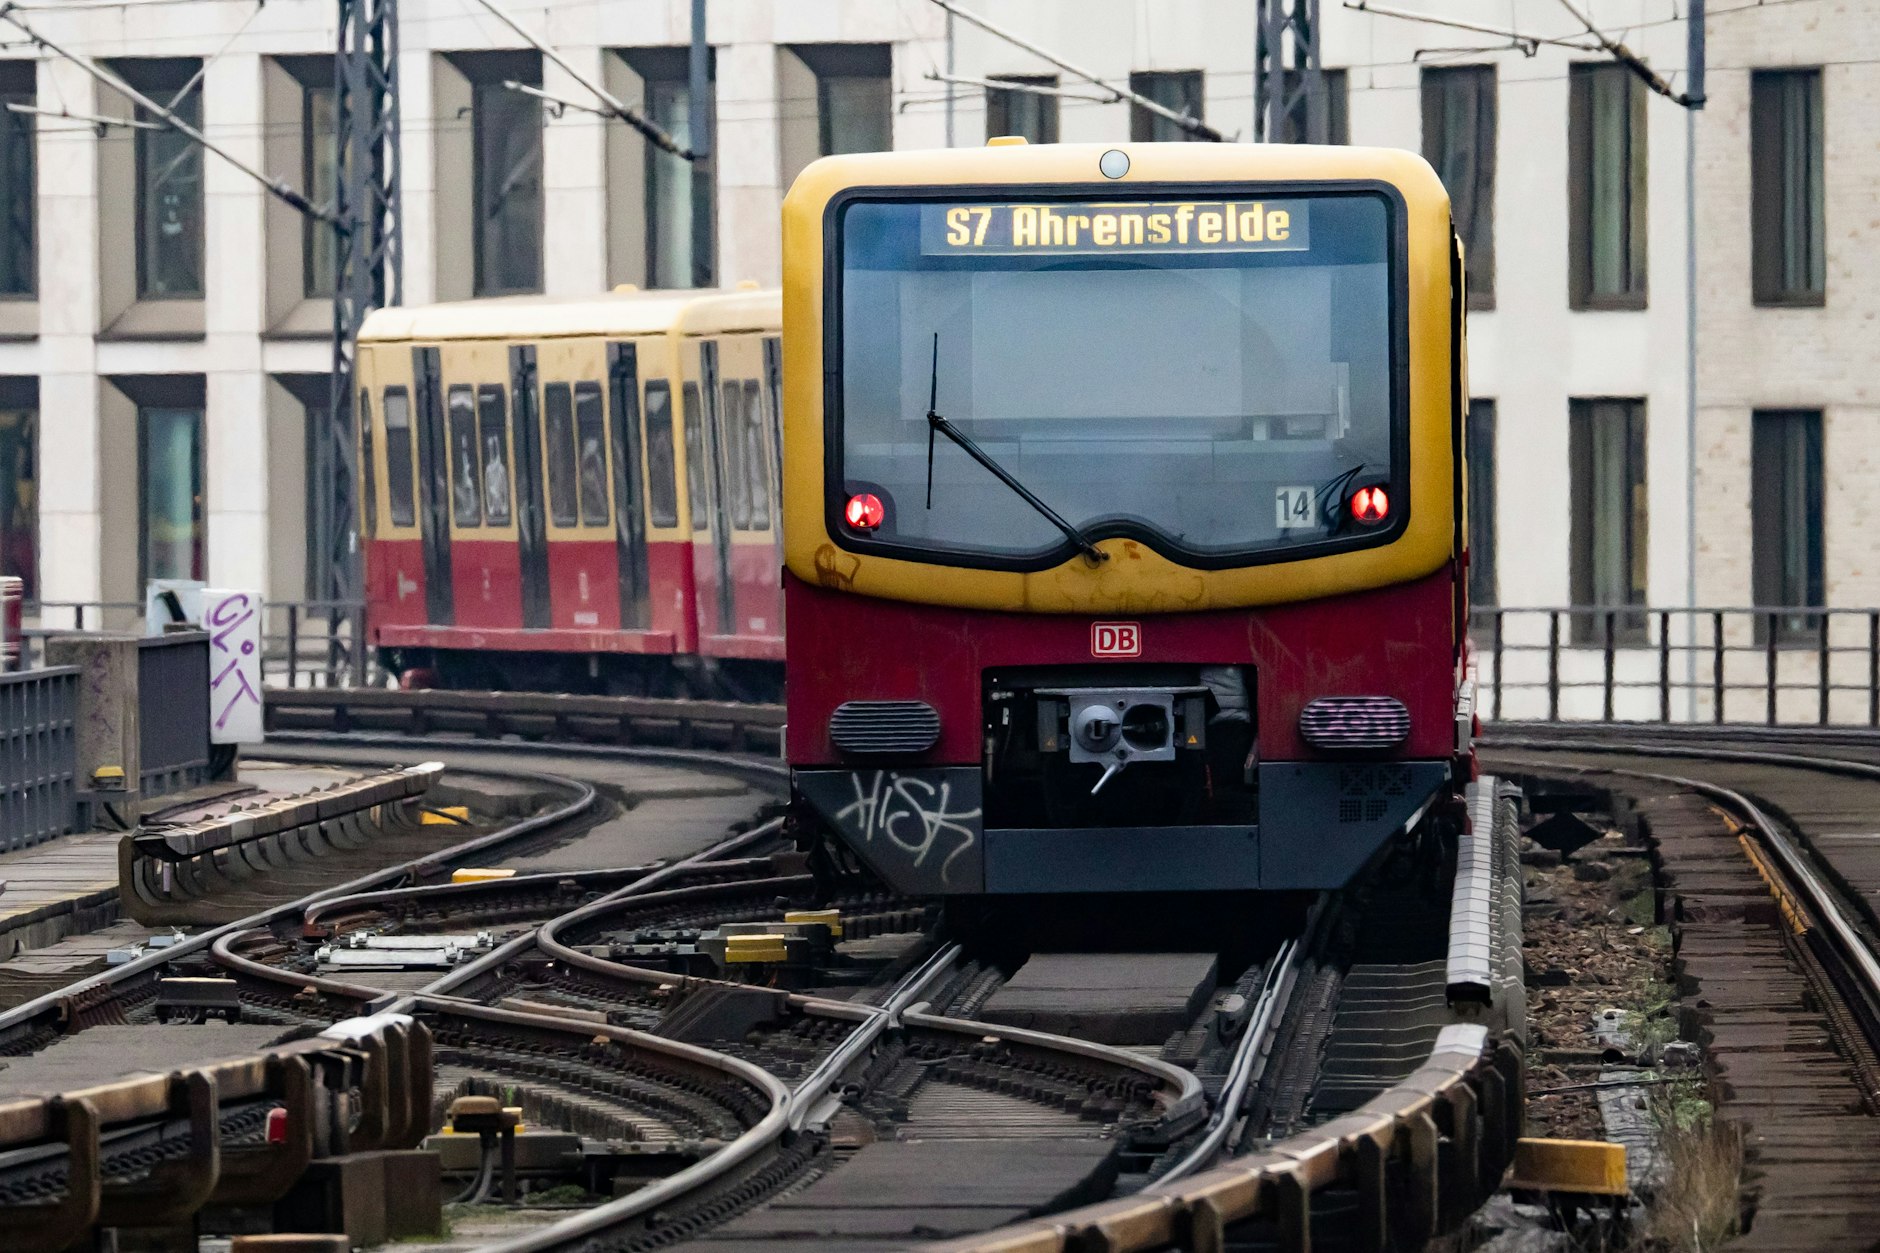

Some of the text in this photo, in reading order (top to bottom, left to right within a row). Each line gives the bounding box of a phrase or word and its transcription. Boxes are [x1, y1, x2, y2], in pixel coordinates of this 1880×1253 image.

[946, 203, 1291, 246] S7 Ahrensfelde
[1276, 490, 1311, 521] 14
[1097, 627, 1136, 652] DB
